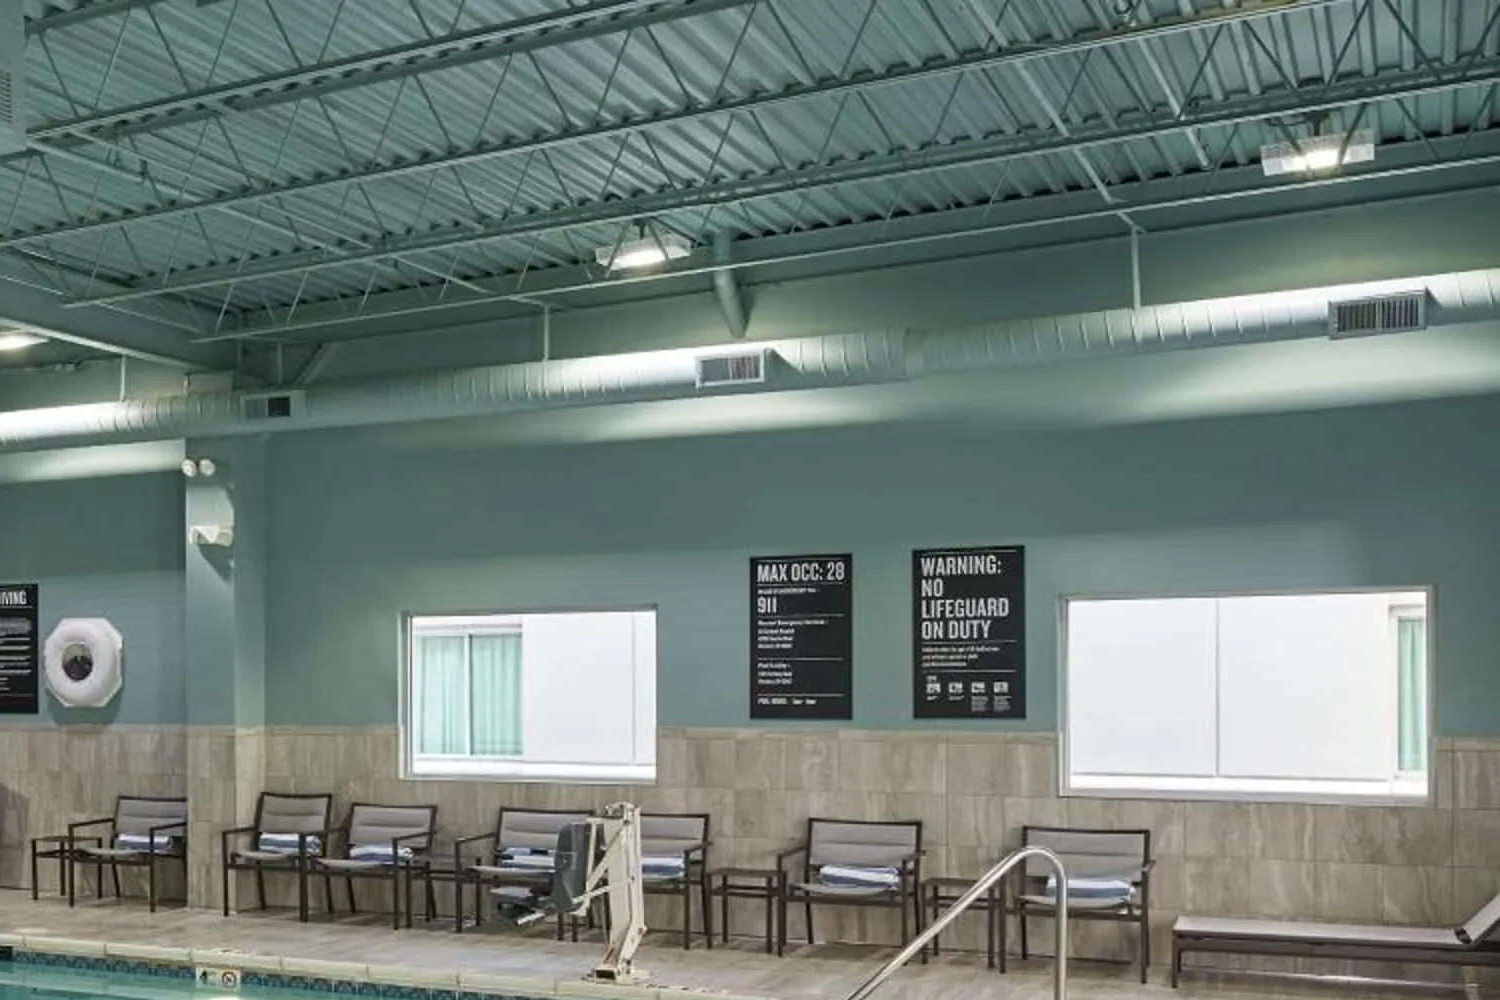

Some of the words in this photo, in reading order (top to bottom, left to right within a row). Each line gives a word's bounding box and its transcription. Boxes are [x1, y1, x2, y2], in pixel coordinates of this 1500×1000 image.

[757, 563, 788, 582] MAX
[791, 563, 823, 581] OCC:
[827, 561, 845, 580] 28
[920, 555, 1002, 577] WARNING:
[921, 578, 943, 597] NO
[757, 596, 777, 613] 911
[921, 597, 1009, 619] LIFEGUARD
[921, 621, 944, 639] ON
[948, 619, 992, 639] DUTY
